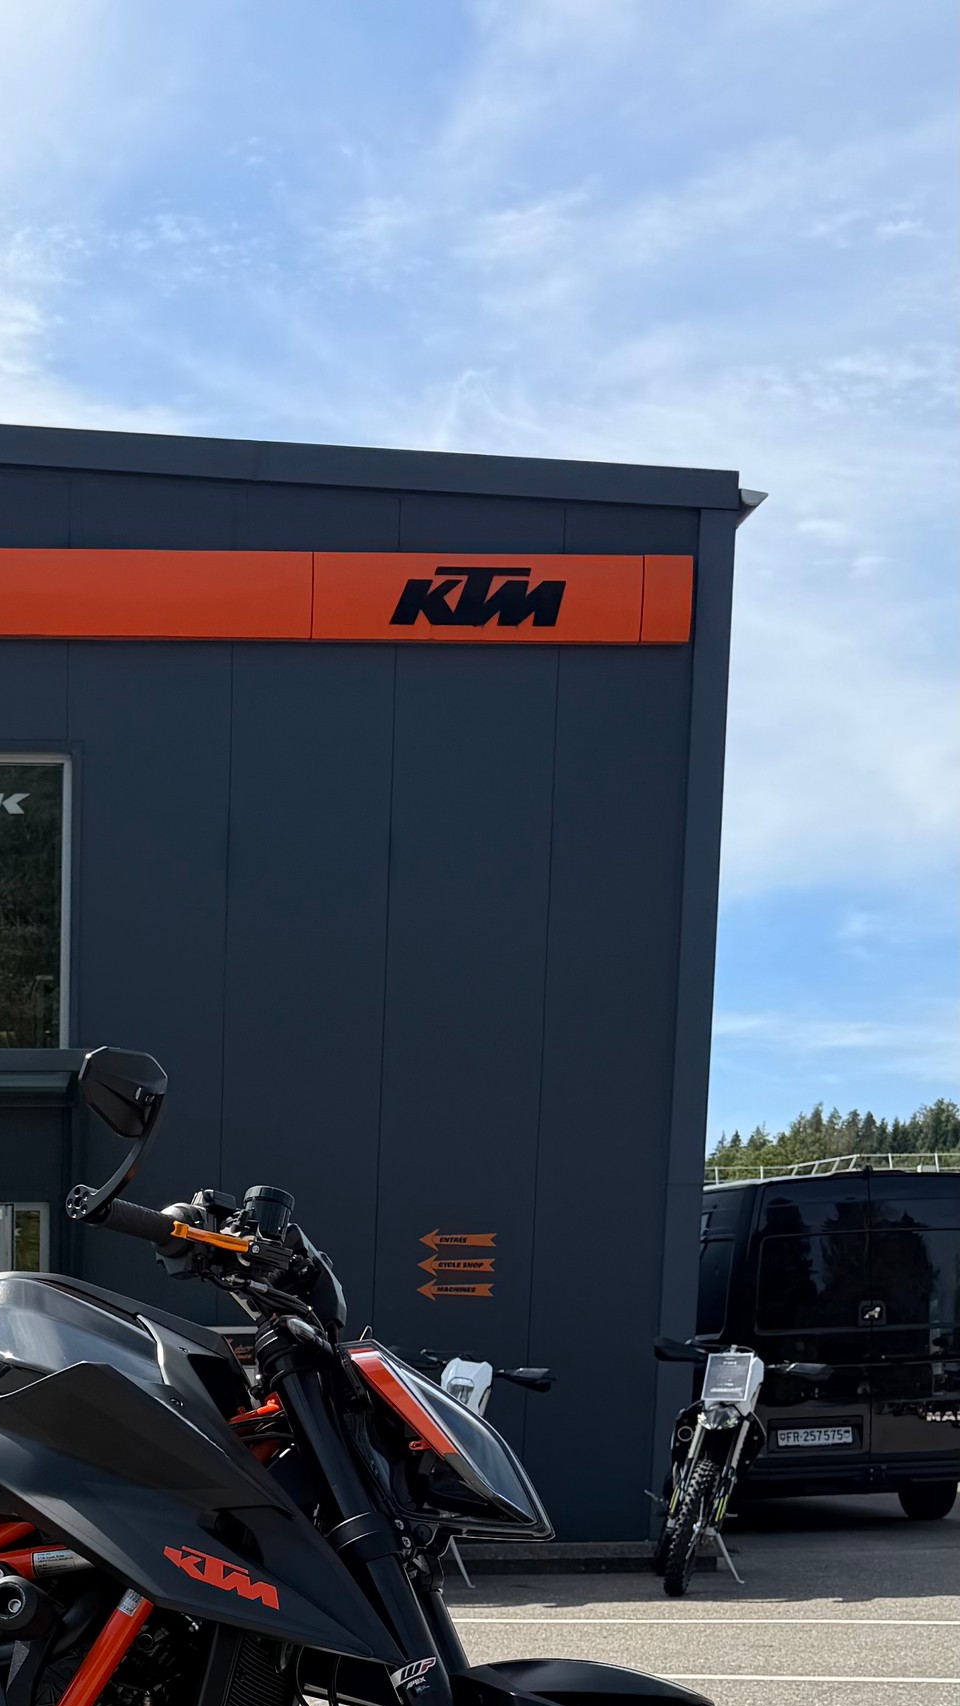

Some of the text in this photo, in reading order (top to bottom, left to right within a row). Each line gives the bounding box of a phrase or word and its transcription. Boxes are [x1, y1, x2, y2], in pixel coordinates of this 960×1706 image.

[389, 566, 567, 627] KTM
[436, 1286, 477, 1294] MACHINES
[926, 1411, 960, 1421] MA
[163, 1545, 280, 1610] KTM
